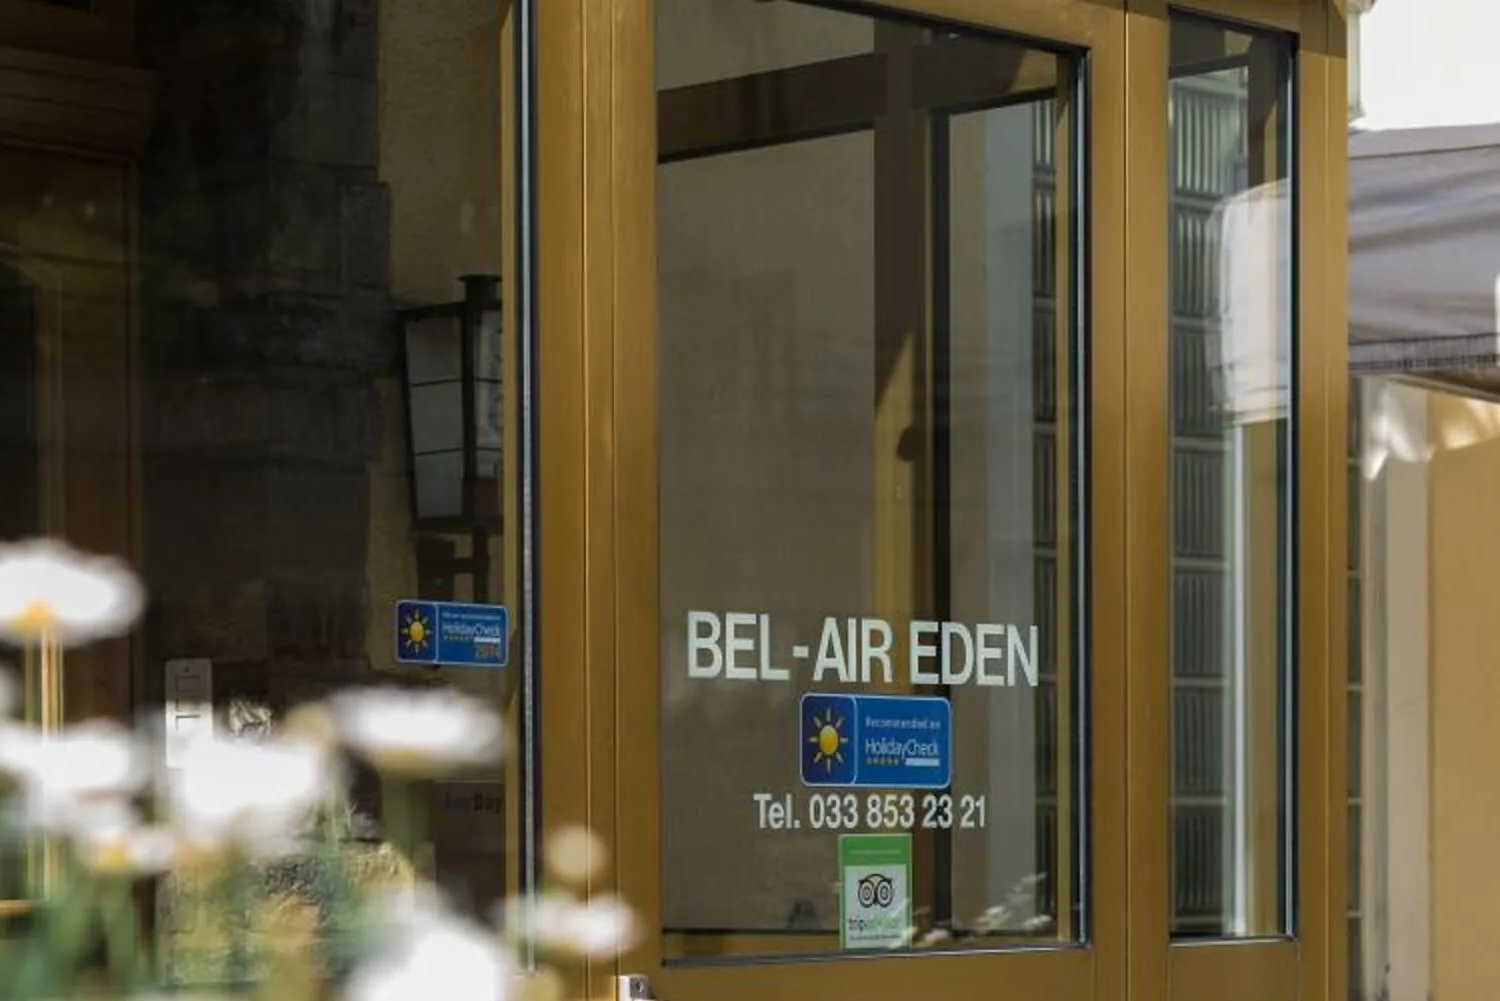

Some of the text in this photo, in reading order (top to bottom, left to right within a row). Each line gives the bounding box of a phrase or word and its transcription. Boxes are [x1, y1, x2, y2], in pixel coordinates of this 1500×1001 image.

[686, 610, 1039, 688] BEL-AIR EDEN
[865, 736, 940, 760] HolidayCheck
[752, 793, 986, 829] Tel. 033 853 23 21
